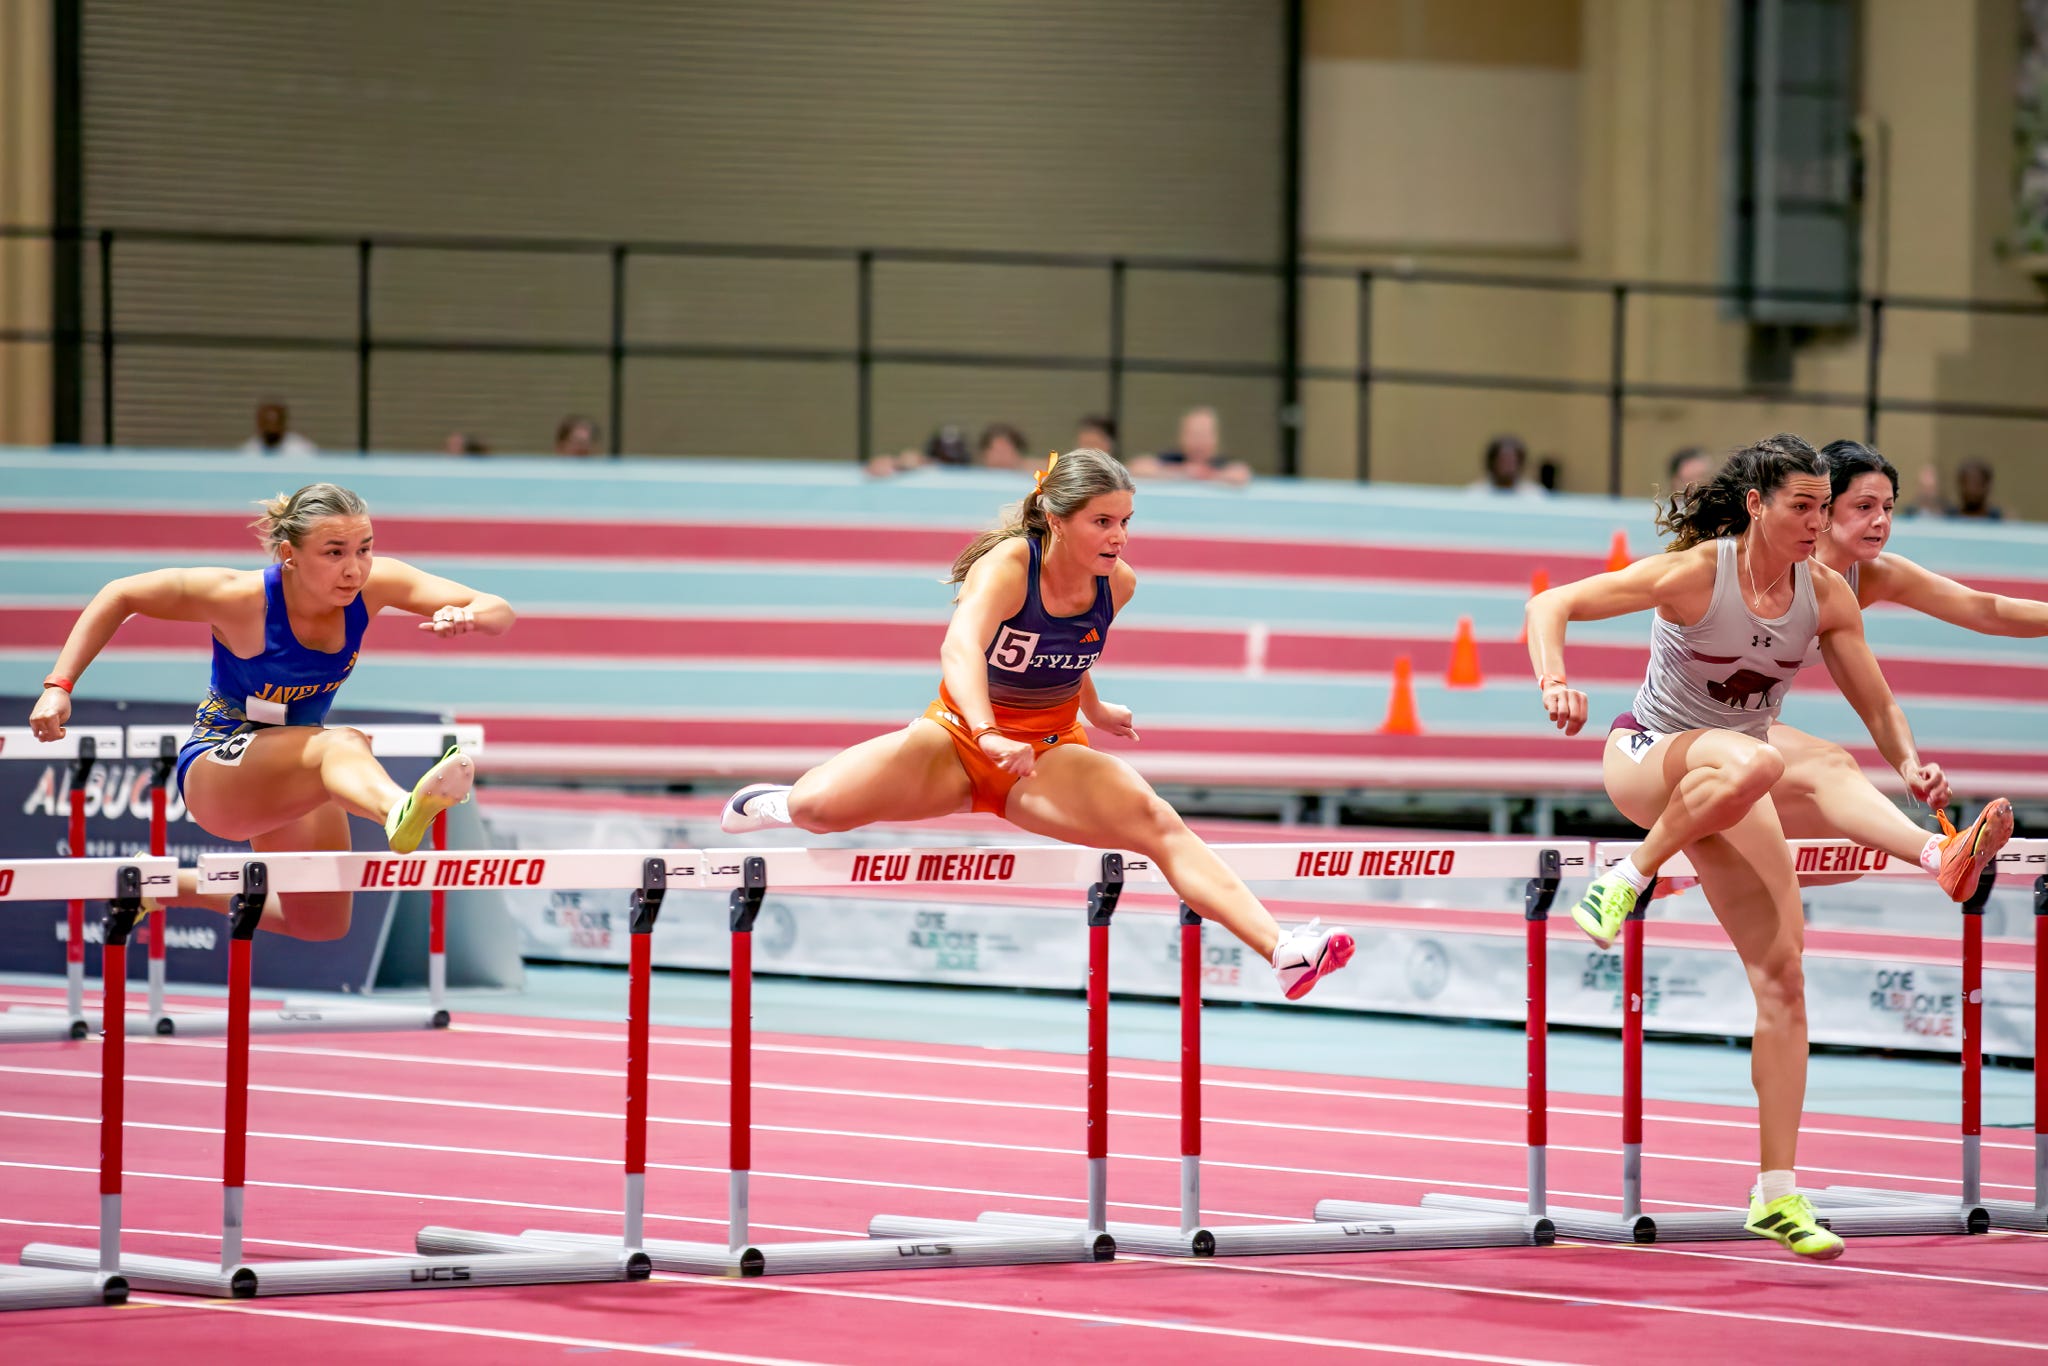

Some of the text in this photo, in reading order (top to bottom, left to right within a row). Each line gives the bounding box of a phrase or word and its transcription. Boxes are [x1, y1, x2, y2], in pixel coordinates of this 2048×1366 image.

[997, 632, 1031, 668] 5
[711, 865, 741, 875] UCS
[851, 854, 1016, 882] NEW MEXICO
[1296, 850, 1455, 877] NEW MEXICO
[1795, 846, 1889, 872] MEXICO
[207, 871, 240, 881] UCS
[360, 858, 546, 888] NEW MEXICO
[410, 1266, 471, 1283] UCS
